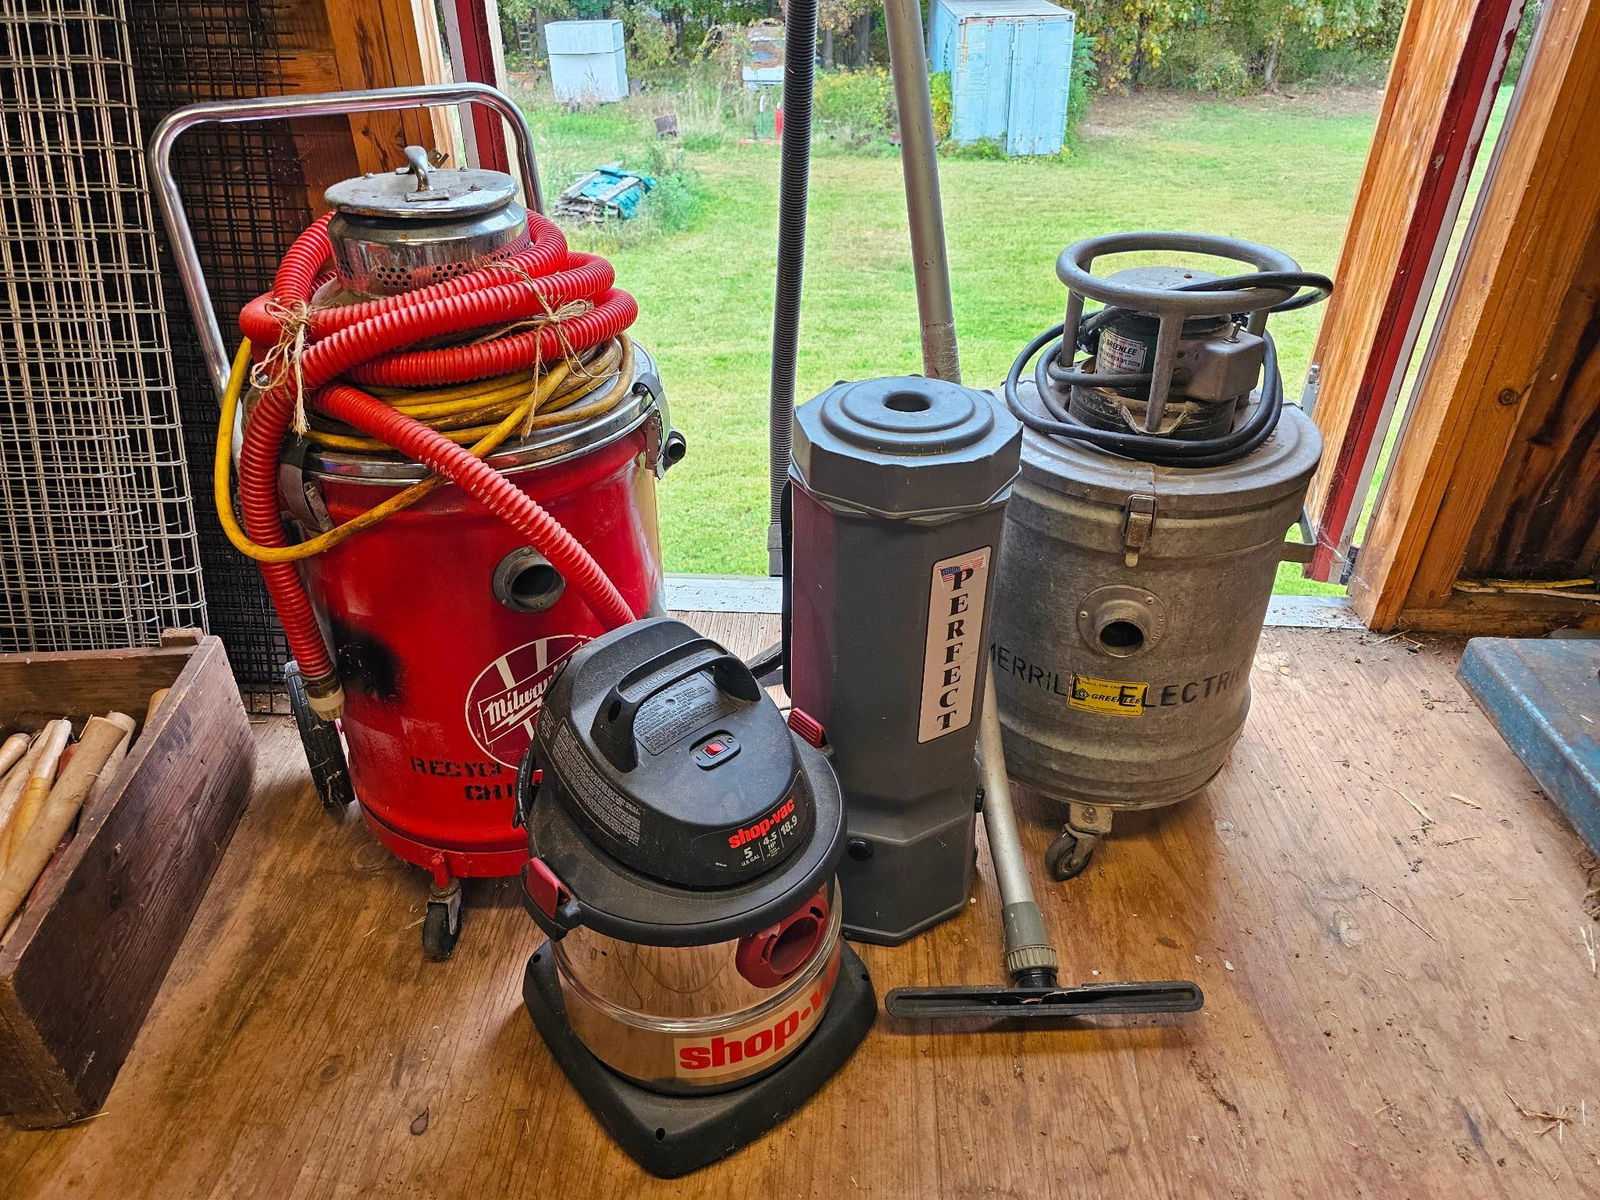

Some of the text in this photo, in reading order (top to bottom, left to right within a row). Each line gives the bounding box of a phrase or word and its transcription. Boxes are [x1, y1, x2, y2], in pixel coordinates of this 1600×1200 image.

[936, 567, 975, 731] PERFECT
[780, 814, 798, 836] 18.9
[763, 831, 778, 846] 4.5
[743, 846, 753, 859] 5
